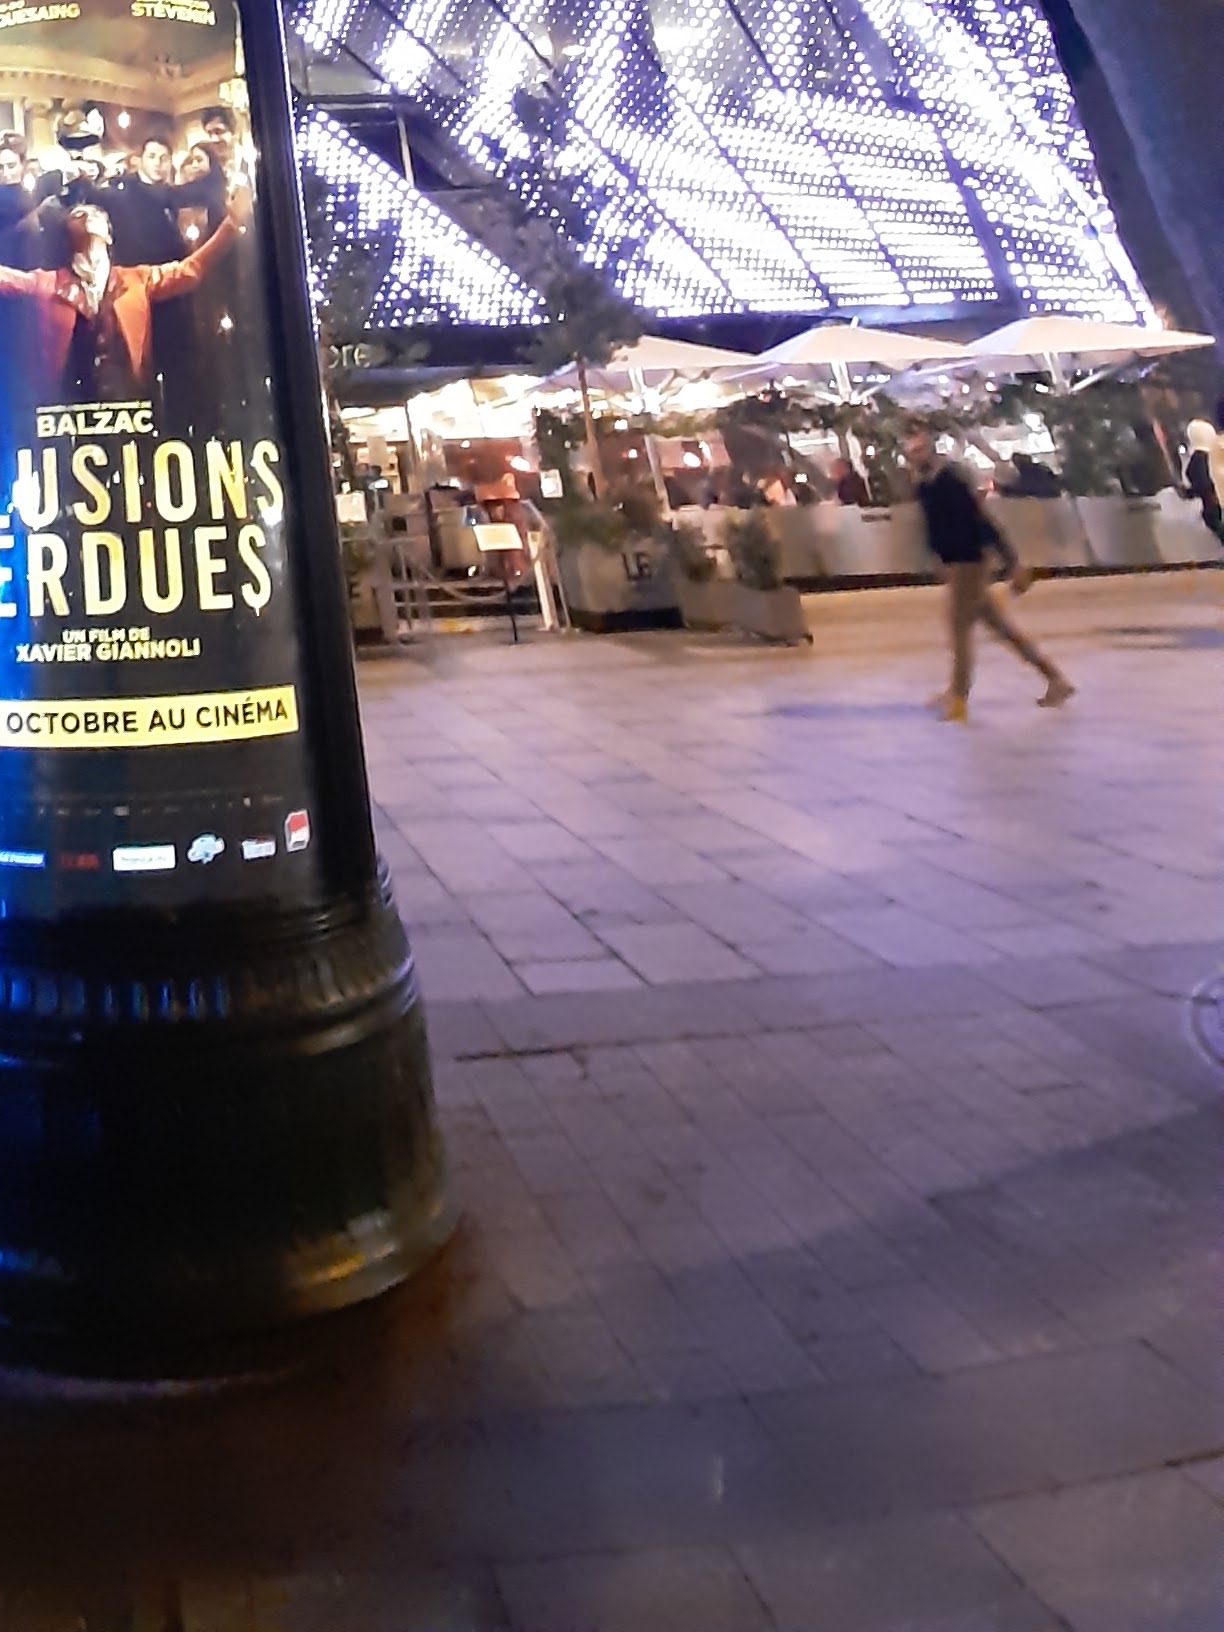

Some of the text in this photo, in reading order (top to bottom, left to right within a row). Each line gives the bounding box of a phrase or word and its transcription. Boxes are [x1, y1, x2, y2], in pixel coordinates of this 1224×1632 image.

[37, 409, 154, 438] BALZAC
[62, 625, 151, 643] UN FILM DE
[15, 637, 201, 663] XAVIER GIANNOLI
[6, 710, 139, 735] OCTOBRE
[148, 708, 186, 732] AU
[196, 696, 290, 728] CINÉMA
